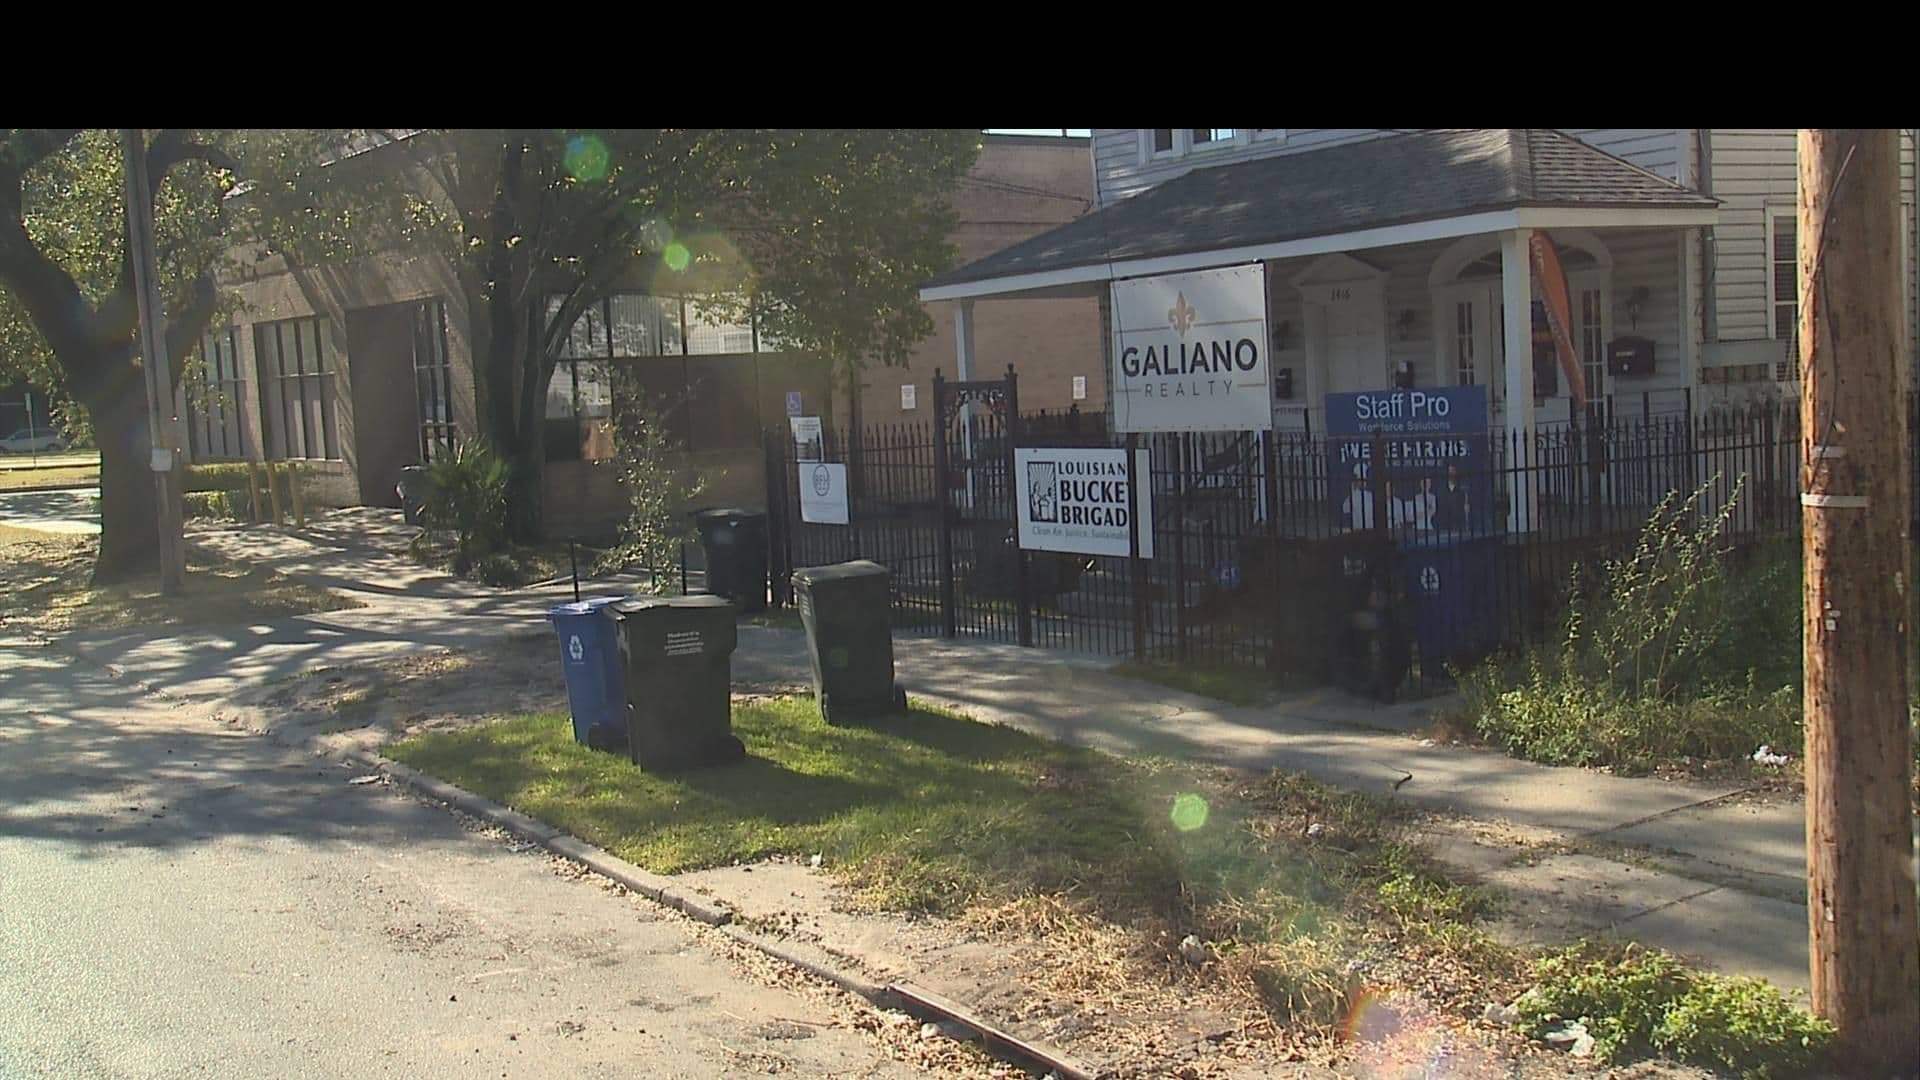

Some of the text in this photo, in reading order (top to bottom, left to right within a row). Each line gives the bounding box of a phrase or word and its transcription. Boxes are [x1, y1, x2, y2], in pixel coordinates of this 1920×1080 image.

[1122, 338, 1258, 377] GALIANO
[1144, 380, 1233, 398] REALTY
[1356, 392, 1450, 419] Staff Pro
[1407, 420, 1450, 432] Solutions
[1058, 461, 1126, 476] LOUISIAN
[1060, 480, 1129, 503] BUCKE
[1061, 506, 1128, 527] BRIGAD
